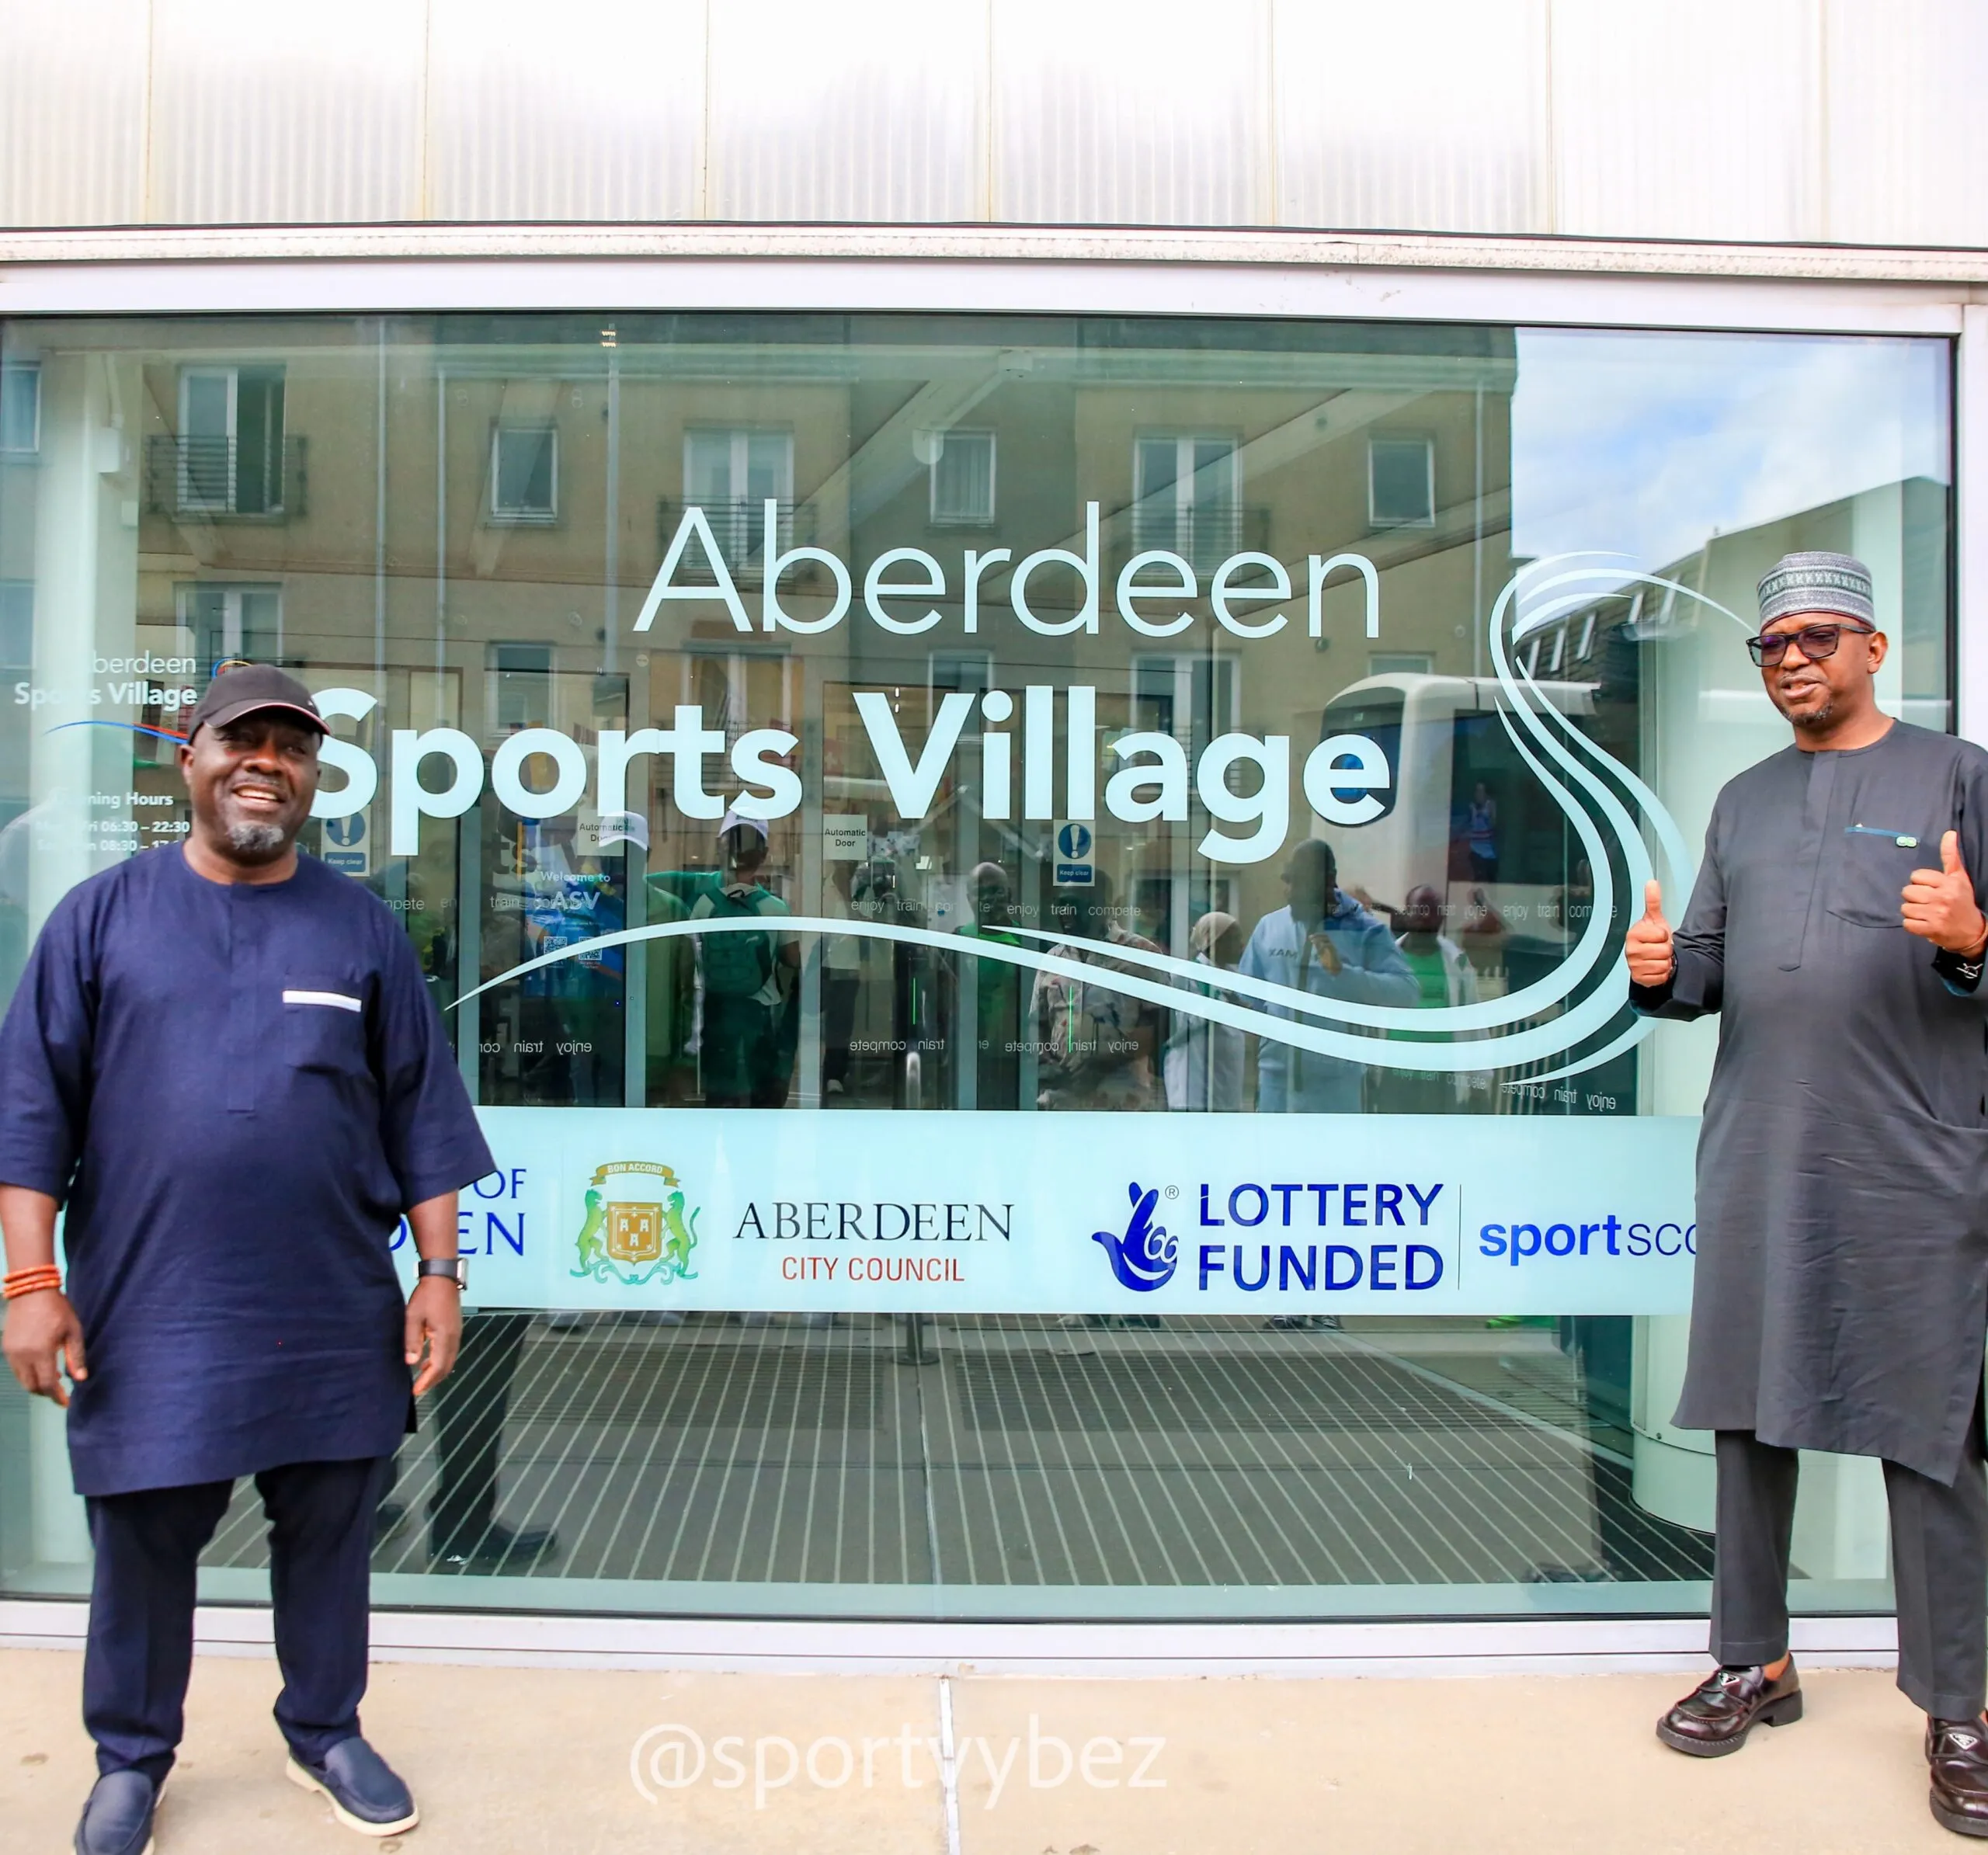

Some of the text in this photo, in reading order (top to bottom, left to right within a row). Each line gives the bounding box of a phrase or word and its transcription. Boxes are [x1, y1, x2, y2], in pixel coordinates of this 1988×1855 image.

[632, 498, 1380, 638] Aberdeen
[90, 650, 197, 674] berdeen
[107, 681, 198, 711] Village
[309, 686, 1391, 864] Sports Village
[126, 792, 174, 806] Hours
[101, 821, 138, 832] 06:30
[151, 821, 190, 833] 22:30
[825, 828, 866, 837] Automatic
[100, 839, 137, 852] 08:30
[835, 839, 856, 847] Door
[540, 870, 611, 883] Welcome to
[1059, 869, 1075, 877] Keep
[489, 895, 520, 908] train
[551, 891, 600, 910] ASV
[851, 899, 885, 913] enjoy
[896, 899, 923, 912] train
[1006, 904, 1142, 919] enjoy train compete
[1503, 901, 1529, 921] enjoy
[1538, 901, 1560, 918] train
[607, 1163, 664, 1174] BON ACCORD
[473, 1168, 527, 1199] OF
[1200, 1183, 1444, 1227] LOTTERY
[732, 1202, 1016, 1242] ABERDEEN
[782, 1256, 965, 1282] CITY COUNCIL
[1198, 1244, 1444, 1292] FUNDED
